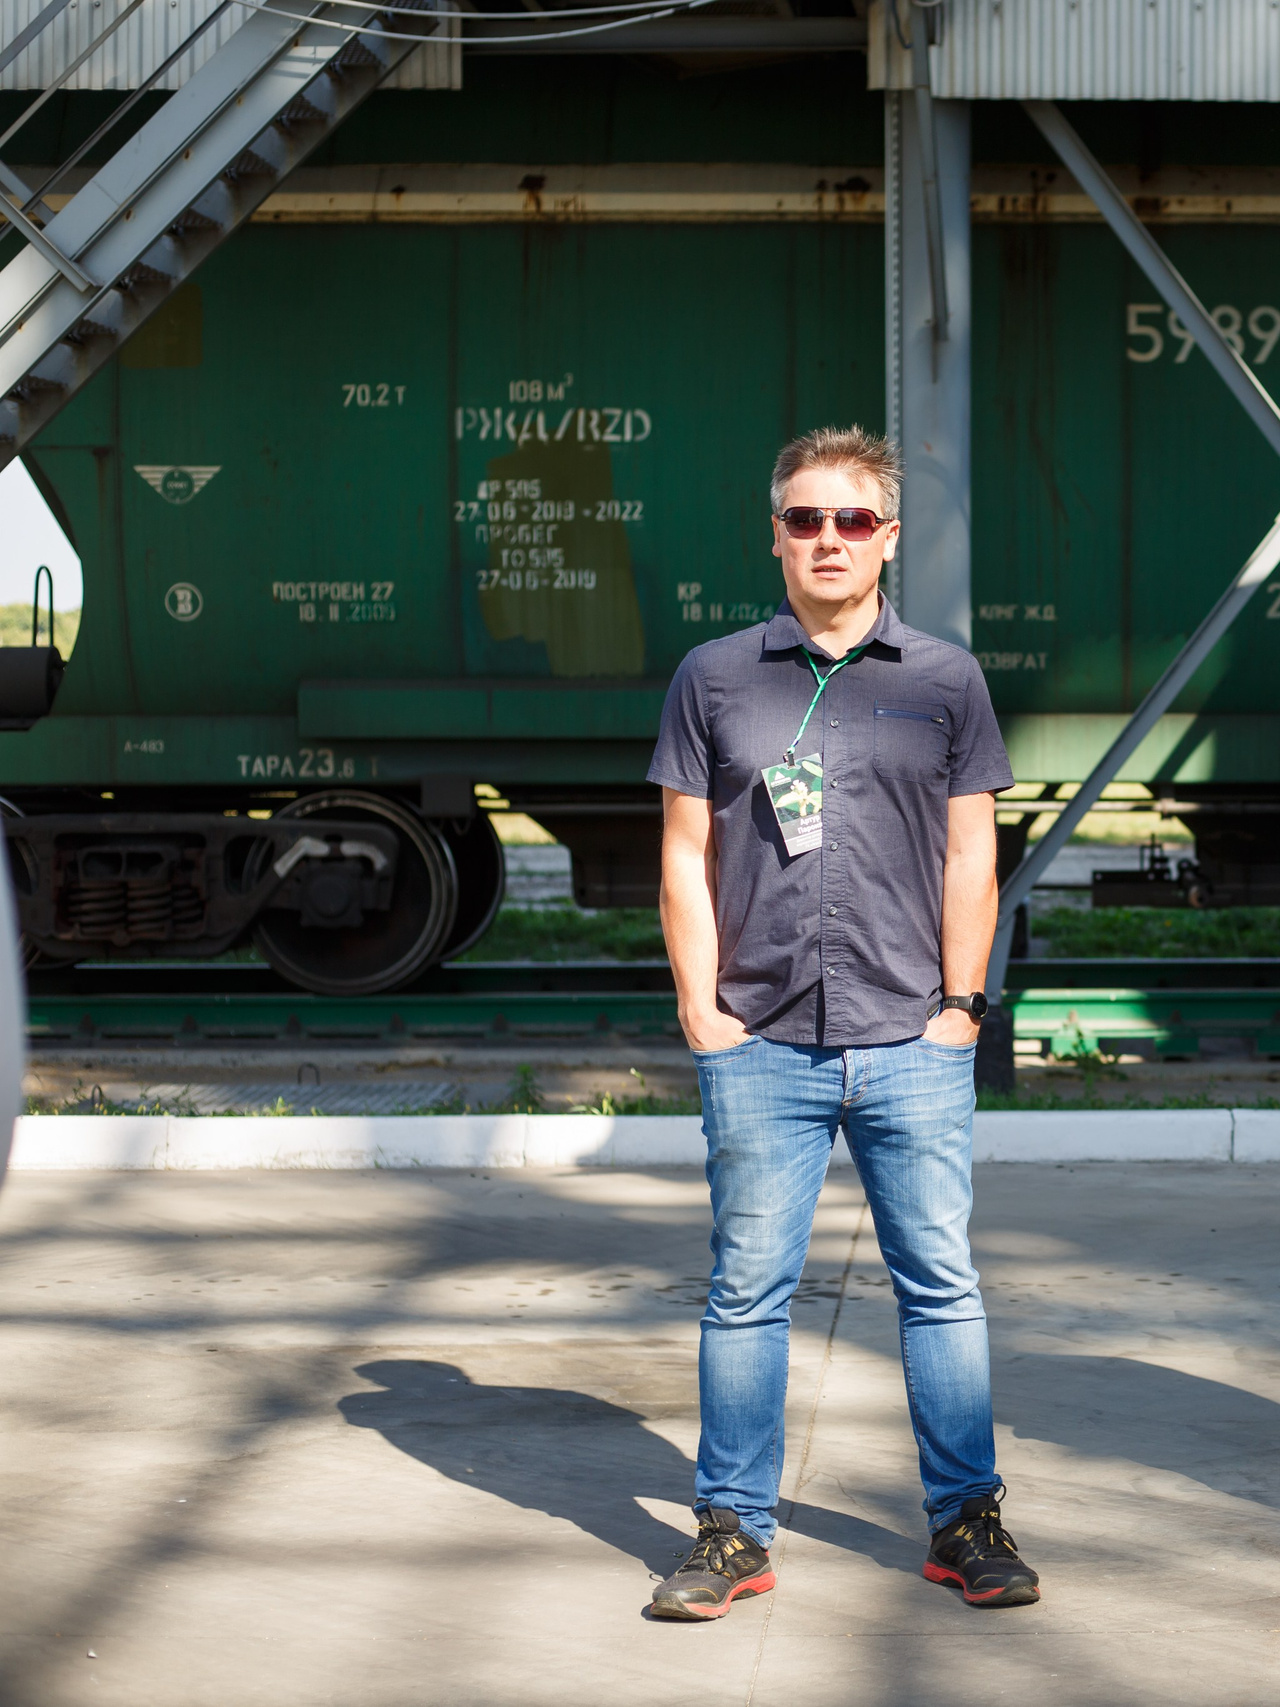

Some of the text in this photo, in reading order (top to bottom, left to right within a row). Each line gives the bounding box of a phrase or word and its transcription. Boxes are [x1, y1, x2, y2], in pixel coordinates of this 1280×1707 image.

[509, 380, 543, 404] 108
[272, 581, 395, 601] ПОСТРОЕН 27
[677, 582, 702, 601] КР
[977, 652, 1049, 670] ОЗВРАТ
[236, 755, 295, 778] ТАРА
